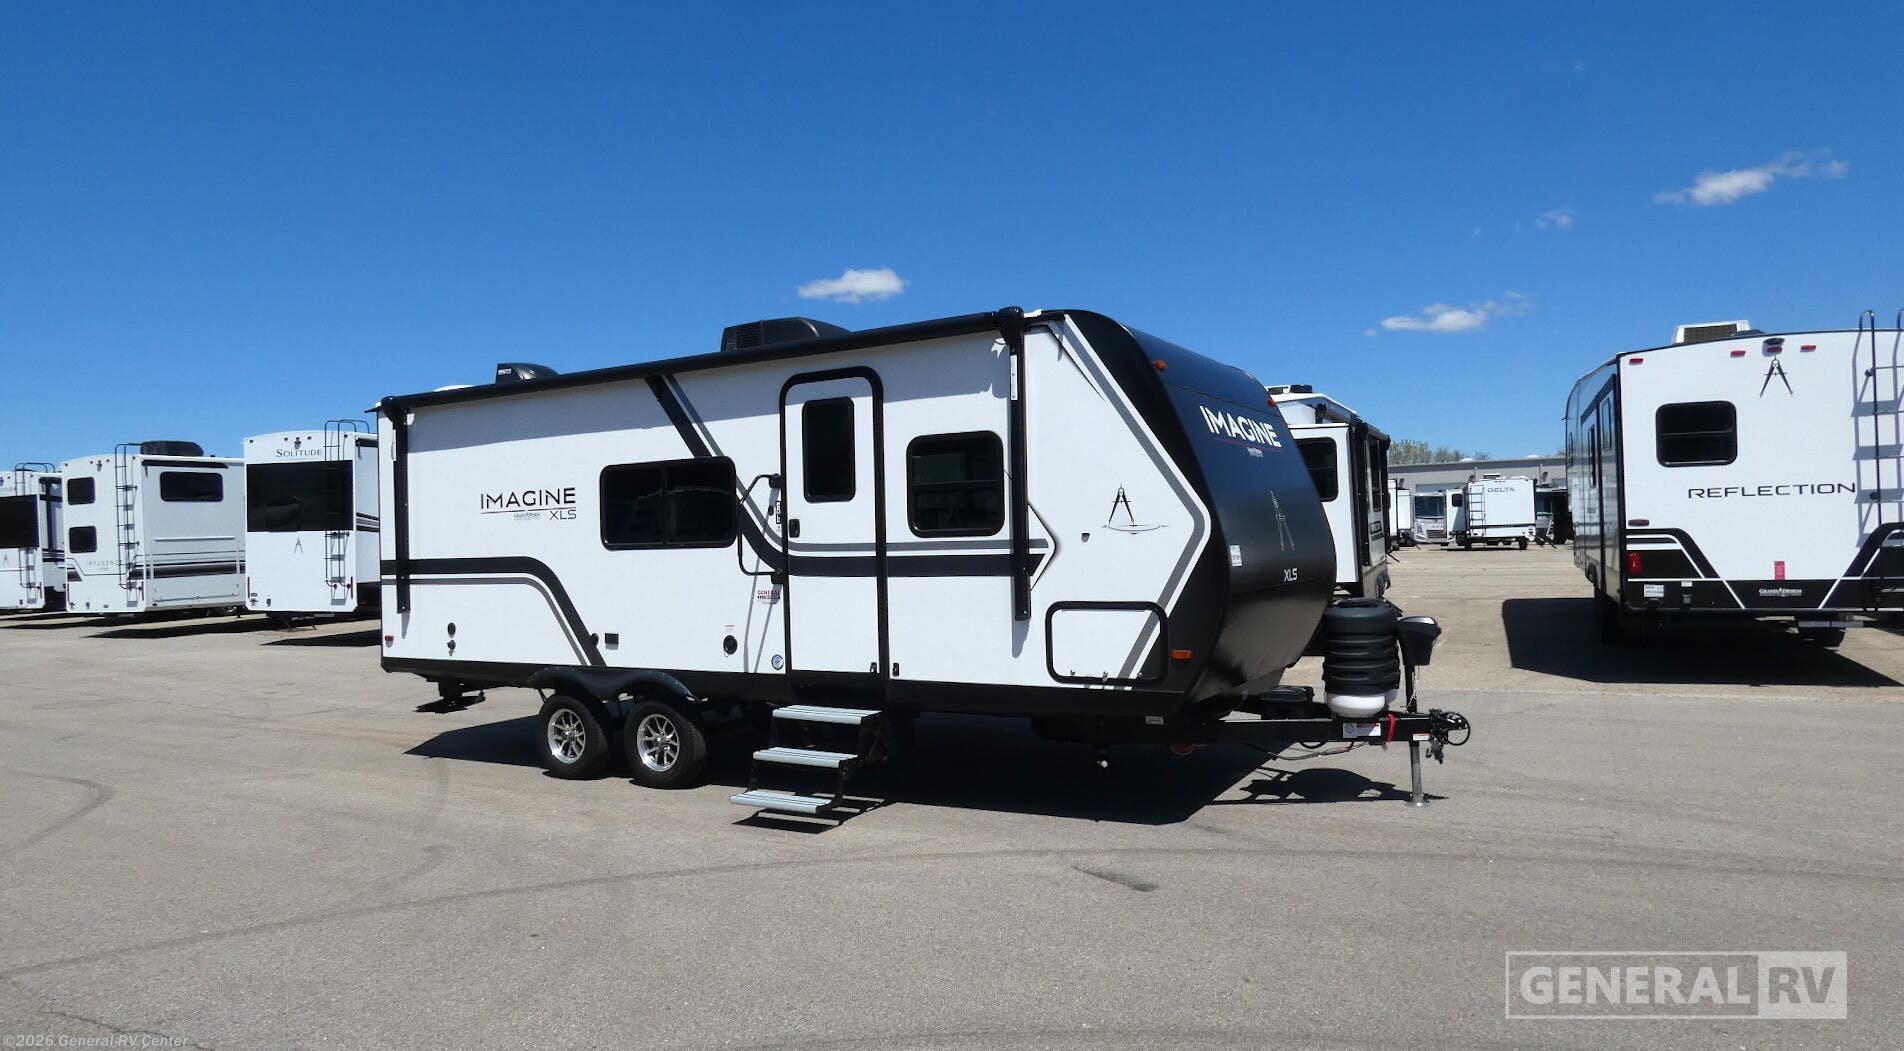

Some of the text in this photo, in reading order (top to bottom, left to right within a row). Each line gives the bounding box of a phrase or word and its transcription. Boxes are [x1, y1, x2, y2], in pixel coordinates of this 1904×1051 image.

[1200, 405, 1282, 448] IMAGINE
[276, 449, 323, 457] SOLITUDE
[1688, 482, 1856, 499] REFLECTION
[480, 487, 576, 510] IMAGINE
[549, 509, 577, 520] XLS
[1284, 568, 1298, 582] XLS
